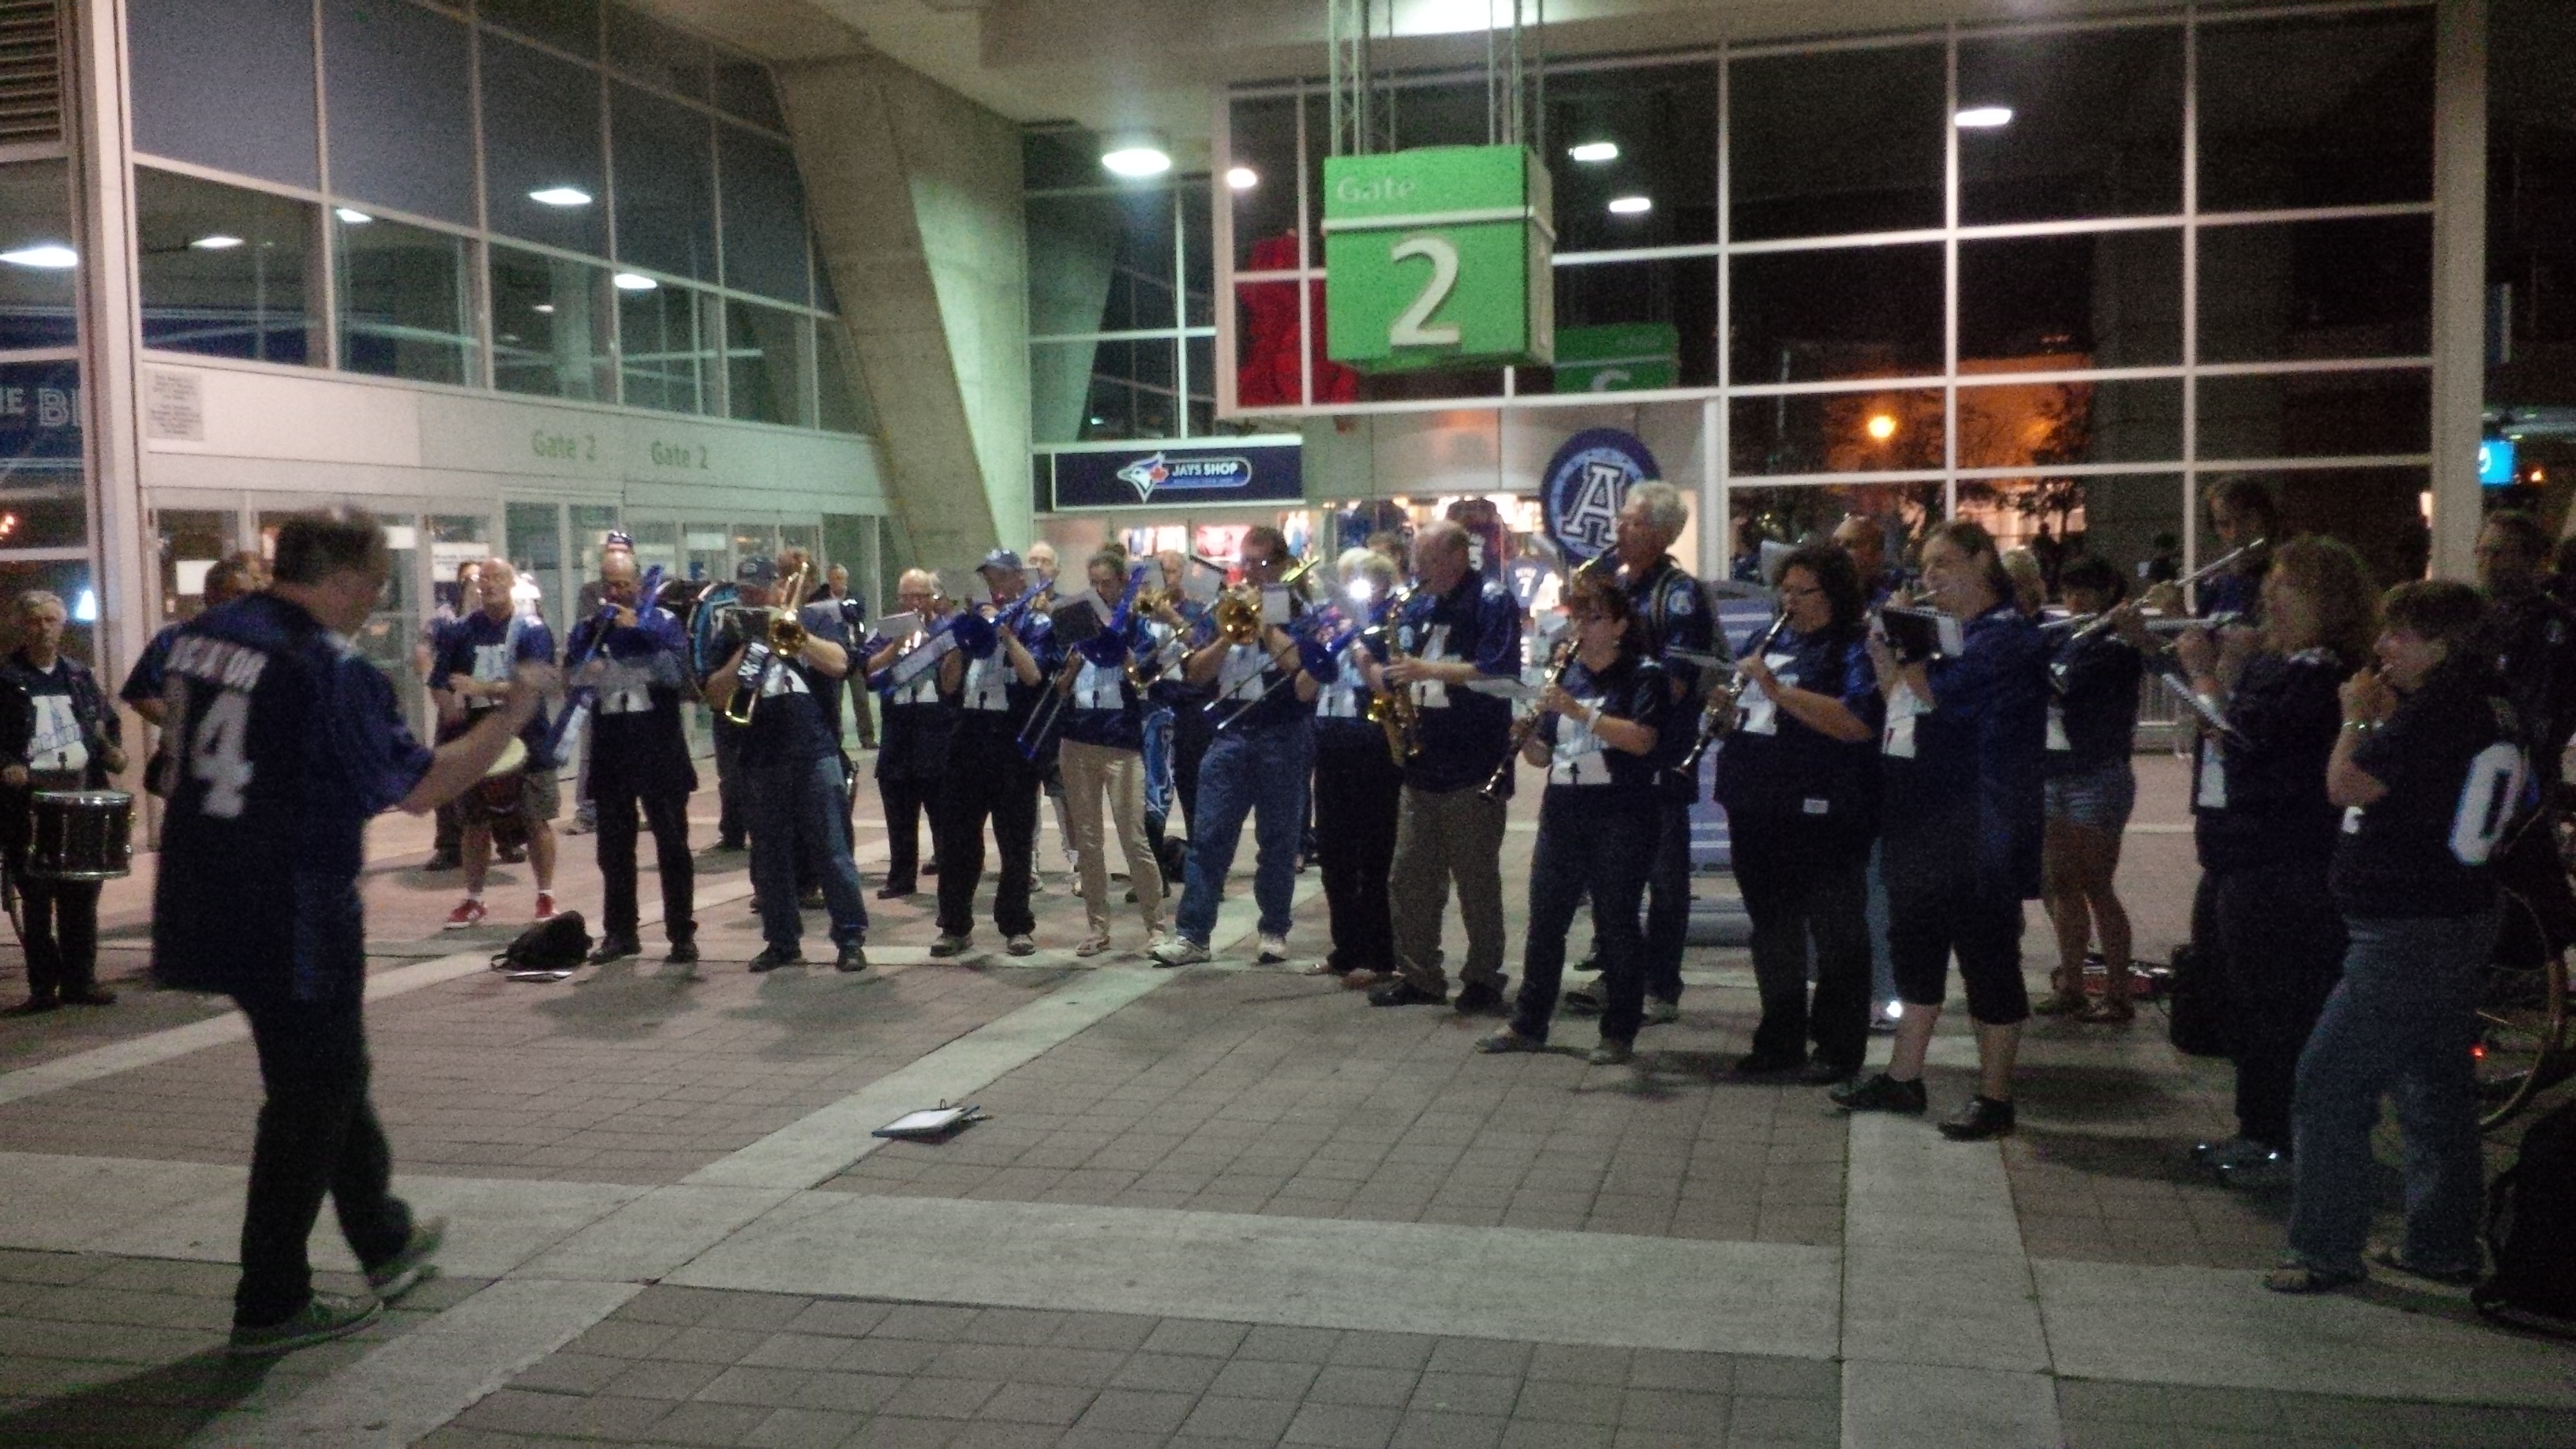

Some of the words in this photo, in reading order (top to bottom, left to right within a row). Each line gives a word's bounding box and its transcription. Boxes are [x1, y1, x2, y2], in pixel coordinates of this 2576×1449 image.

[1337, 175, 1415, 203] Gate
[1390, 236, 1459, 346] 2
[531, 429, 576, 460] Gate
[585, 433, 596, 462] 2
[650, 440, 691, 467] Gate
[698, 444, 708, 470] 2
[1172, 463, 1201, 477] JAYS
[1204, 461, 1238, 476] SHOP
